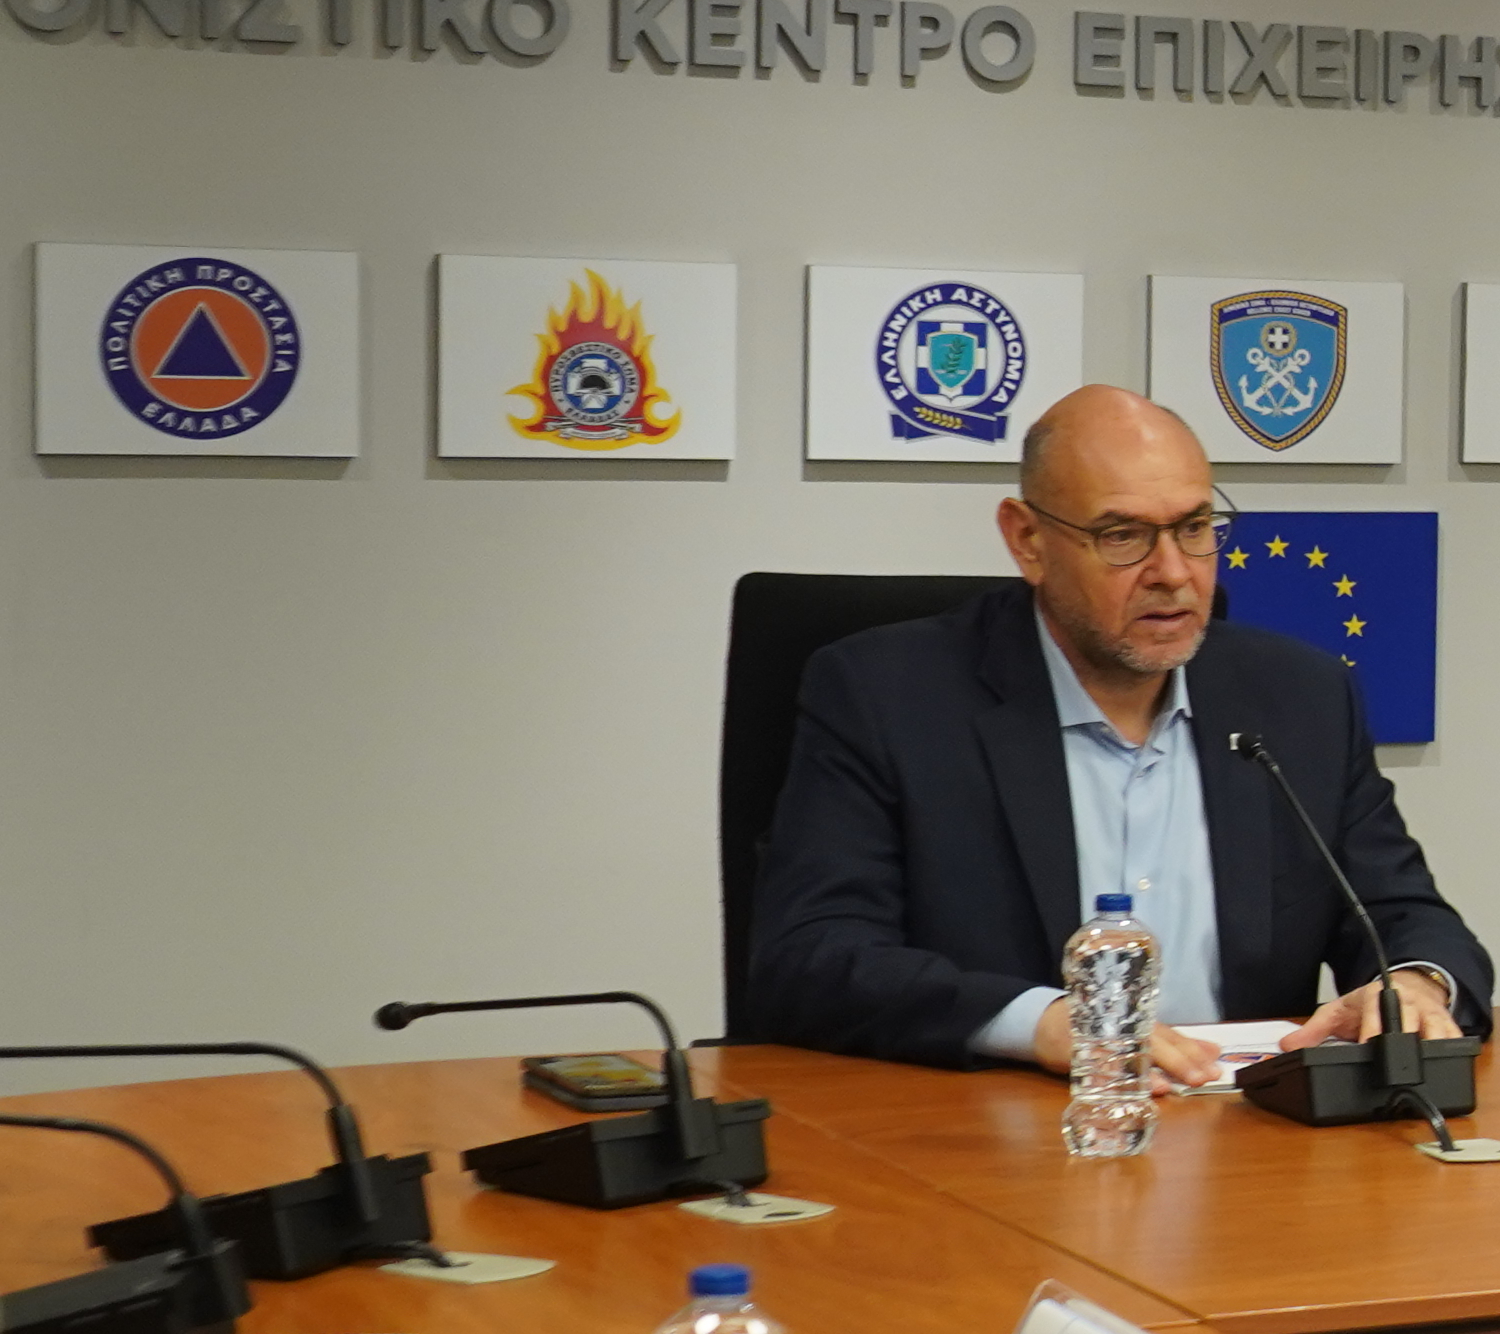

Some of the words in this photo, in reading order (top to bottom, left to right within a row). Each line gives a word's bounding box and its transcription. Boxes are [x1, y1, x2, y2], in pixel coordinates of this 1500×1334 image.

[107, 267, 186, 371] ΠΟΛΙΤΙΚΗ
[196, 265, 296, 372] ΠΡΟΣΤΑΣΙΑ
[881, 289, 943, 400] ΕΛΛΗΝΙΚΗ
[950, 287, 1023, 403] ΑΣΤΥΝΟΜΙΑ
[141, 401, 259, 432] ΕΛΛΑΔΑ
